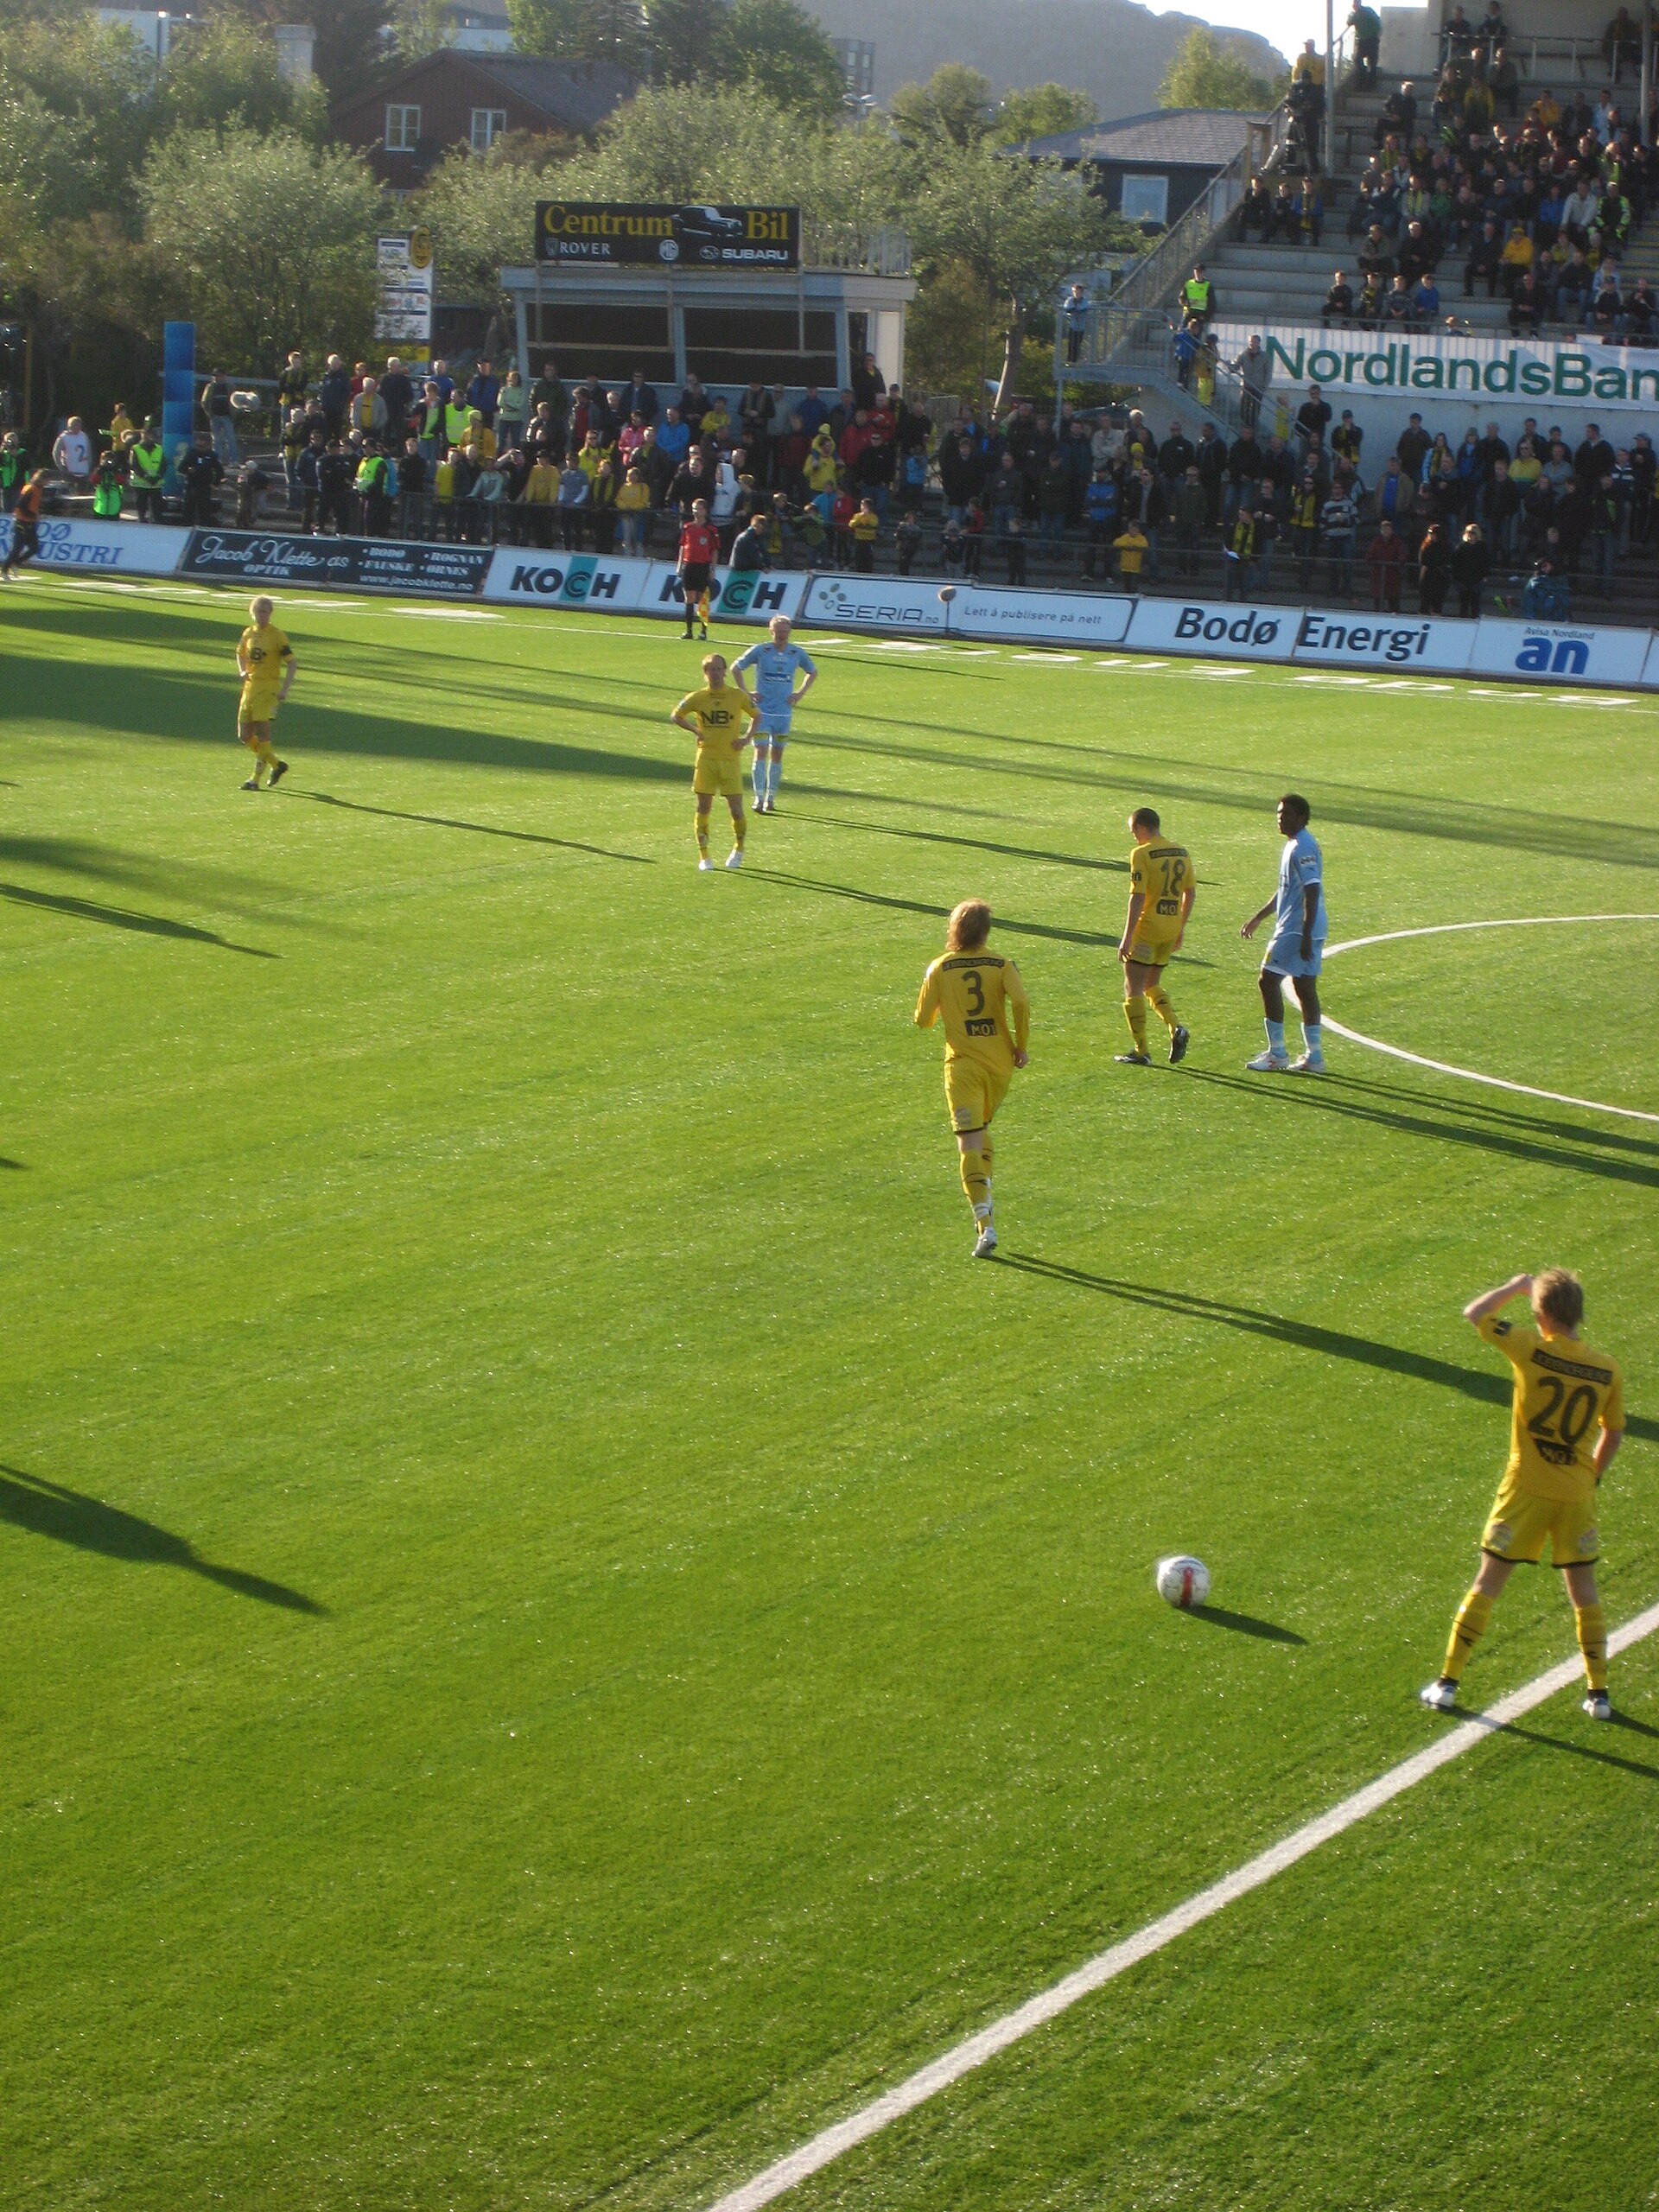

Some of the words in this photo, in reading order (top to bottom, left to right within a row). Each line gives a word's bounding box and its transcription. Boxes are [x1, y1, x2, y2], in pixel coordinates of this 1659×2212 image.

[544, 205, 674, 236] Centrum
[746, 211, 789, 240] Bil
[560, 241, 611, 255] ROVER
[721, 248, 789, 260] SUBARU
[0, 518, 72, 542] BDØ
[195, 536, 258, 563] Jacob
[260, 539, 325, 567] Klette
[243, 563, 289, 576] OPTIK
[510, 565, 621, 599] KOCH
[964, 606, 988, 616] Lett
[1001, 610, 1057, 621] publisere
[1174, 607, 1281, 647] Bodø
[1297, 615, 1431, 662] Energi
[1552, 629, 1595, 639] Nordland
[1515, 637, 1590, 676] an
[1159, 858, 1186, 897] 18
[962, 970, 985, 1017] 3
[1527, 1376, 1598, 1446] 20
